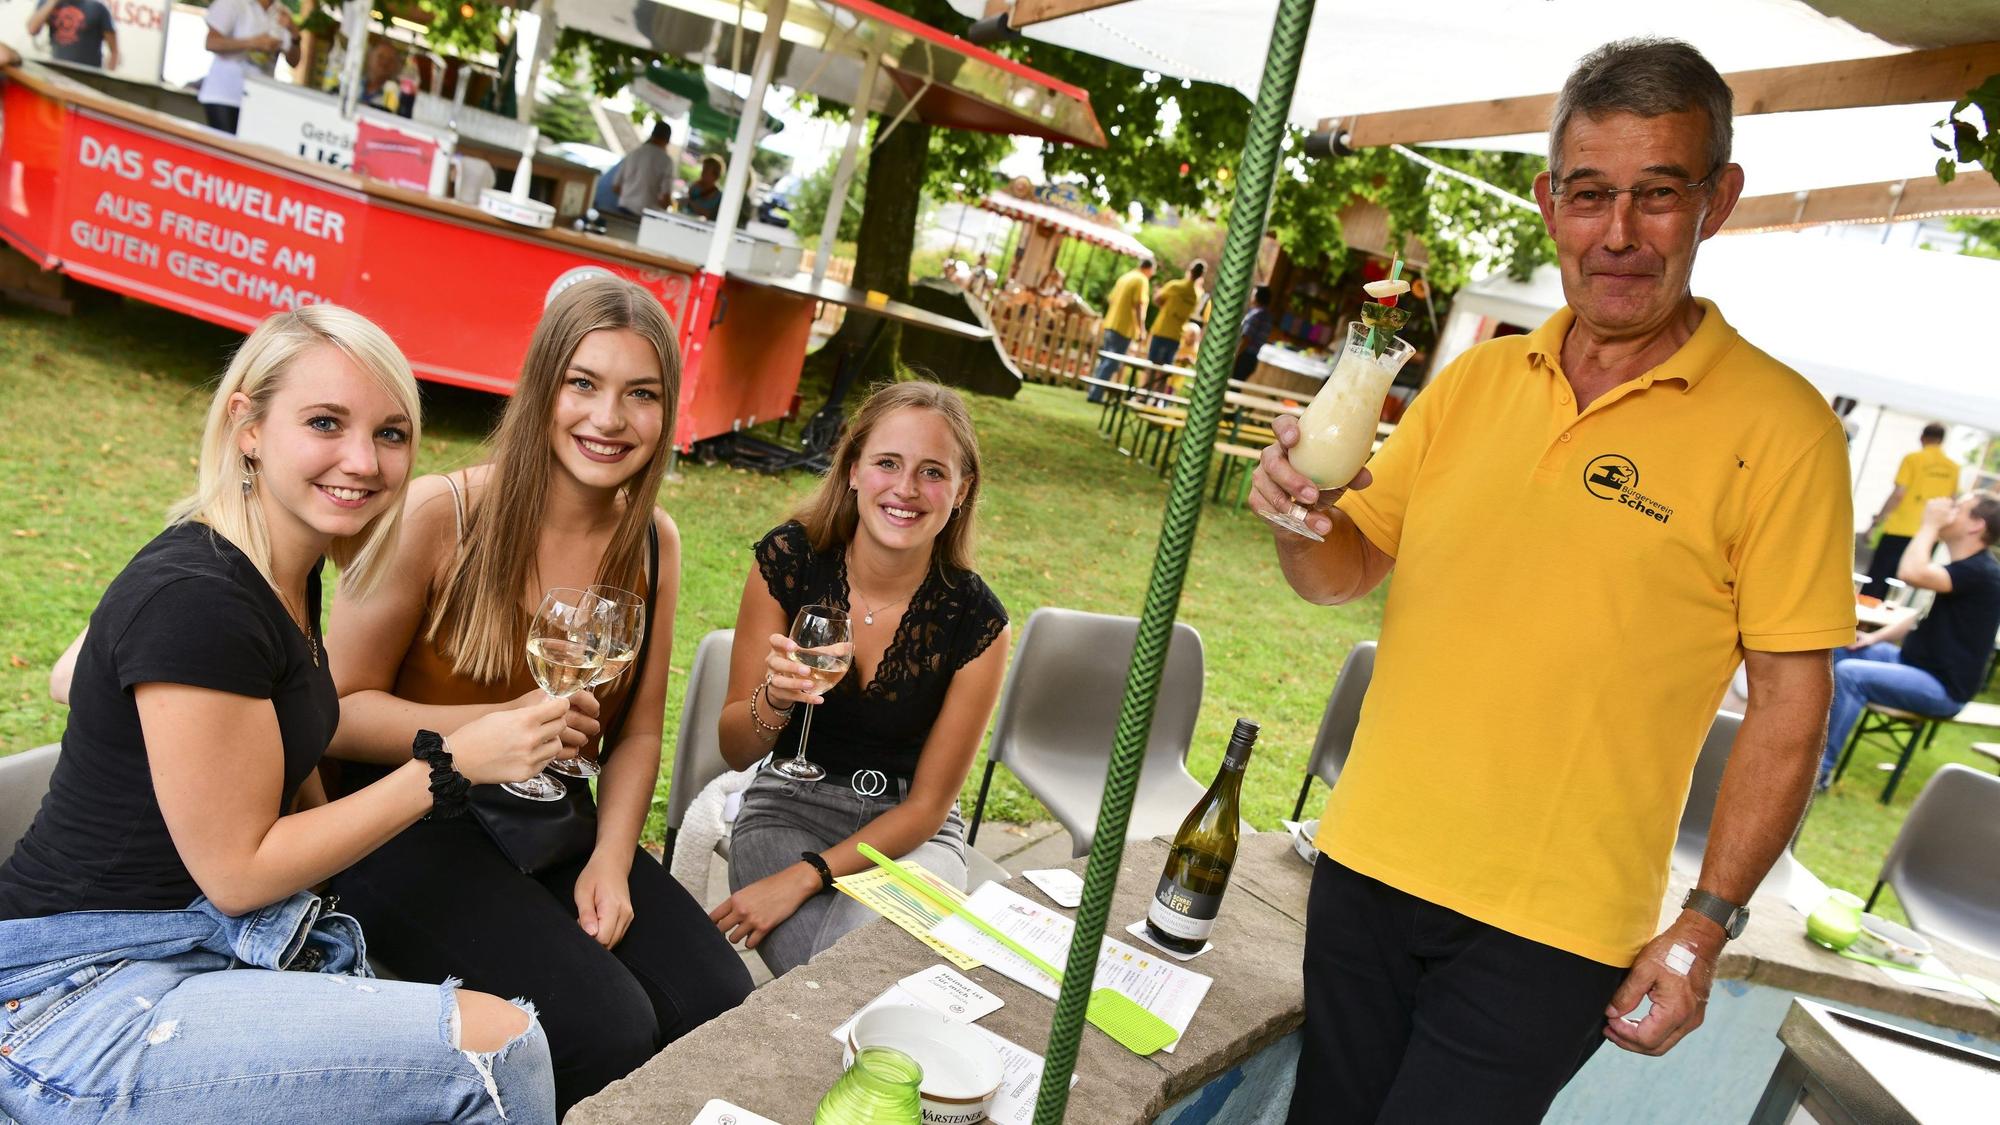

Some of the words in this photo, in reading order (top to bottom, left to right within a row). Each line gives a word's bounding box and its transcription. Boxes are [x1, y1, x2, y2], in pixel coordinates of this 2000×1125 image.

[79, 135, 144, 180] DAS
[151, 159, 345, 243] SCHWELMER
[70, 220, 160, 268] GUTEN
[95, 191, 152, 228] AUS
[160, 209, 268, 265] FREUDE
[272, 247, 315, 281] AM
[1618, 494, 1669, 524] Scheel
[1621, 485, 1674, 516] Bürgerverein
[1170, 900, 1190, 914] ECK
